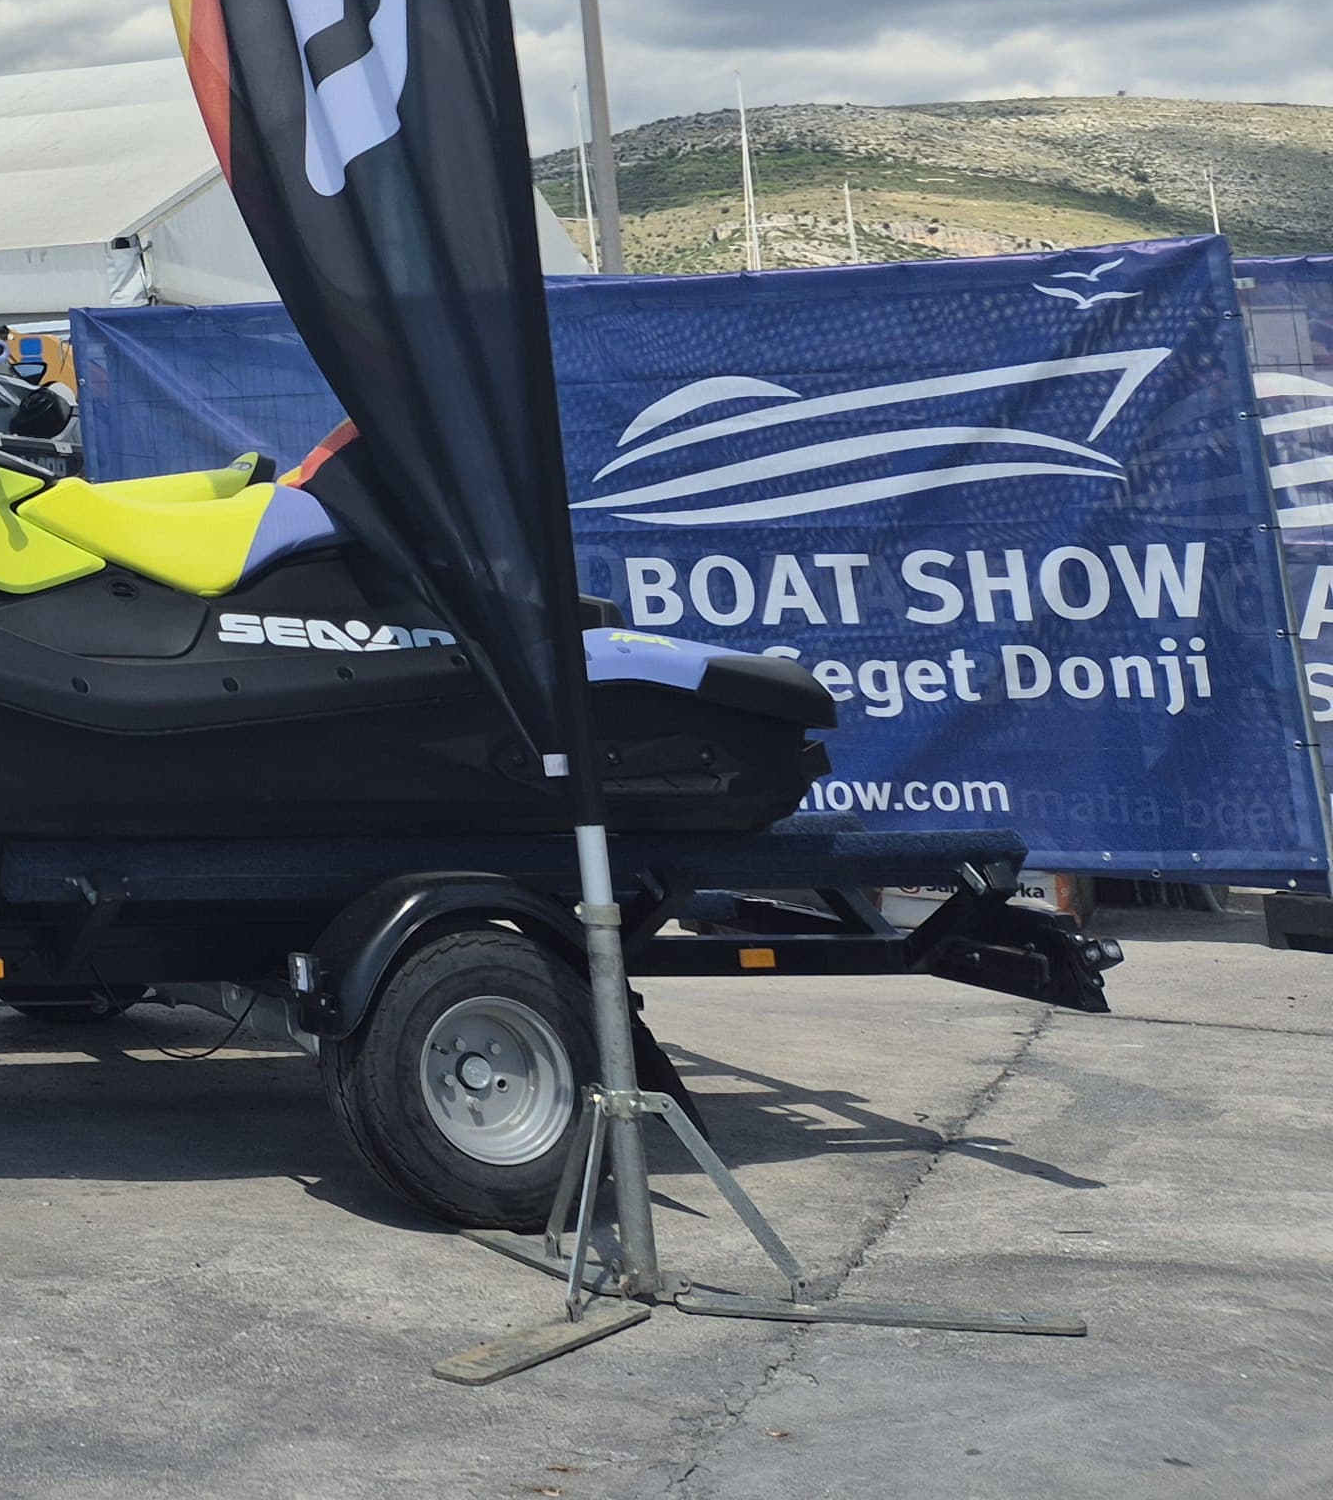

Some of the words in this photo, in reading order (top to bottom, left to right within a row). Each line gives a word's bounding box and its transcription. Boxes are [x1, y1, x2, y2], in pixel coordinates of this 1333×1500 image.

[625, 553, 870, 626] BOAT
[901, 542, 1206, 625] SHOW
[762, 645, 982, 717] eget
[1001, 637, 1211, 715] Donji
